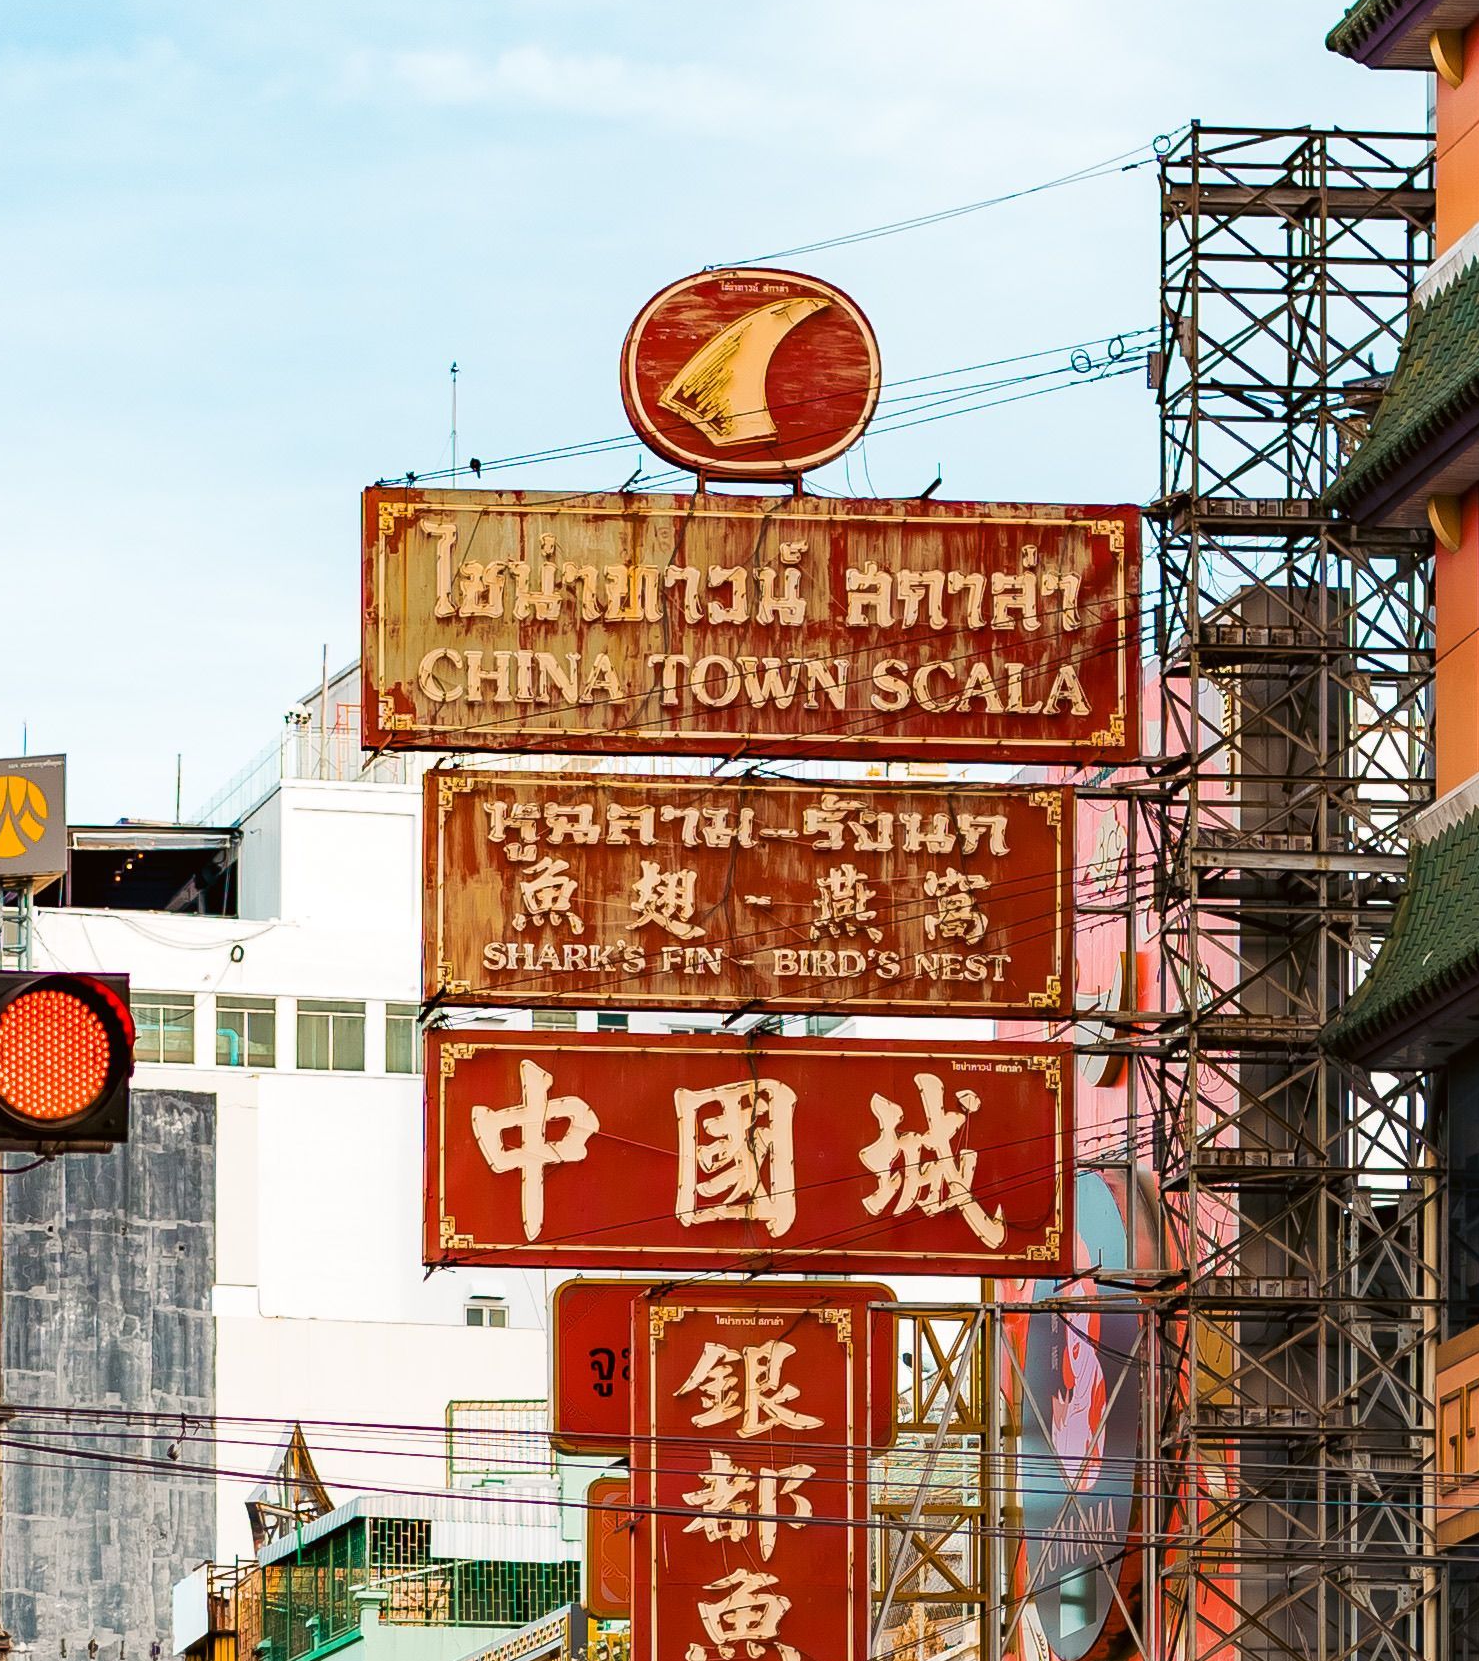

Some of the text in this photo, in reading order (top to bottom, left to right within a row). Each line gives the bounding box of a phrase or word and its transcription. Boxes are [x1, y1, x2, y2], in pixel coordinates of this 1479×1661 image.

[420, 519, 1082, 632] ไชน่าทาวน์ สกาล่า
[417, 646, 1092, 716] CHINA TOWN SCALA
[483, 940, 1012, 983] SHARK'S FIN BIRD'S NEST
[470, 1058, 1008, 1249] 中國城
